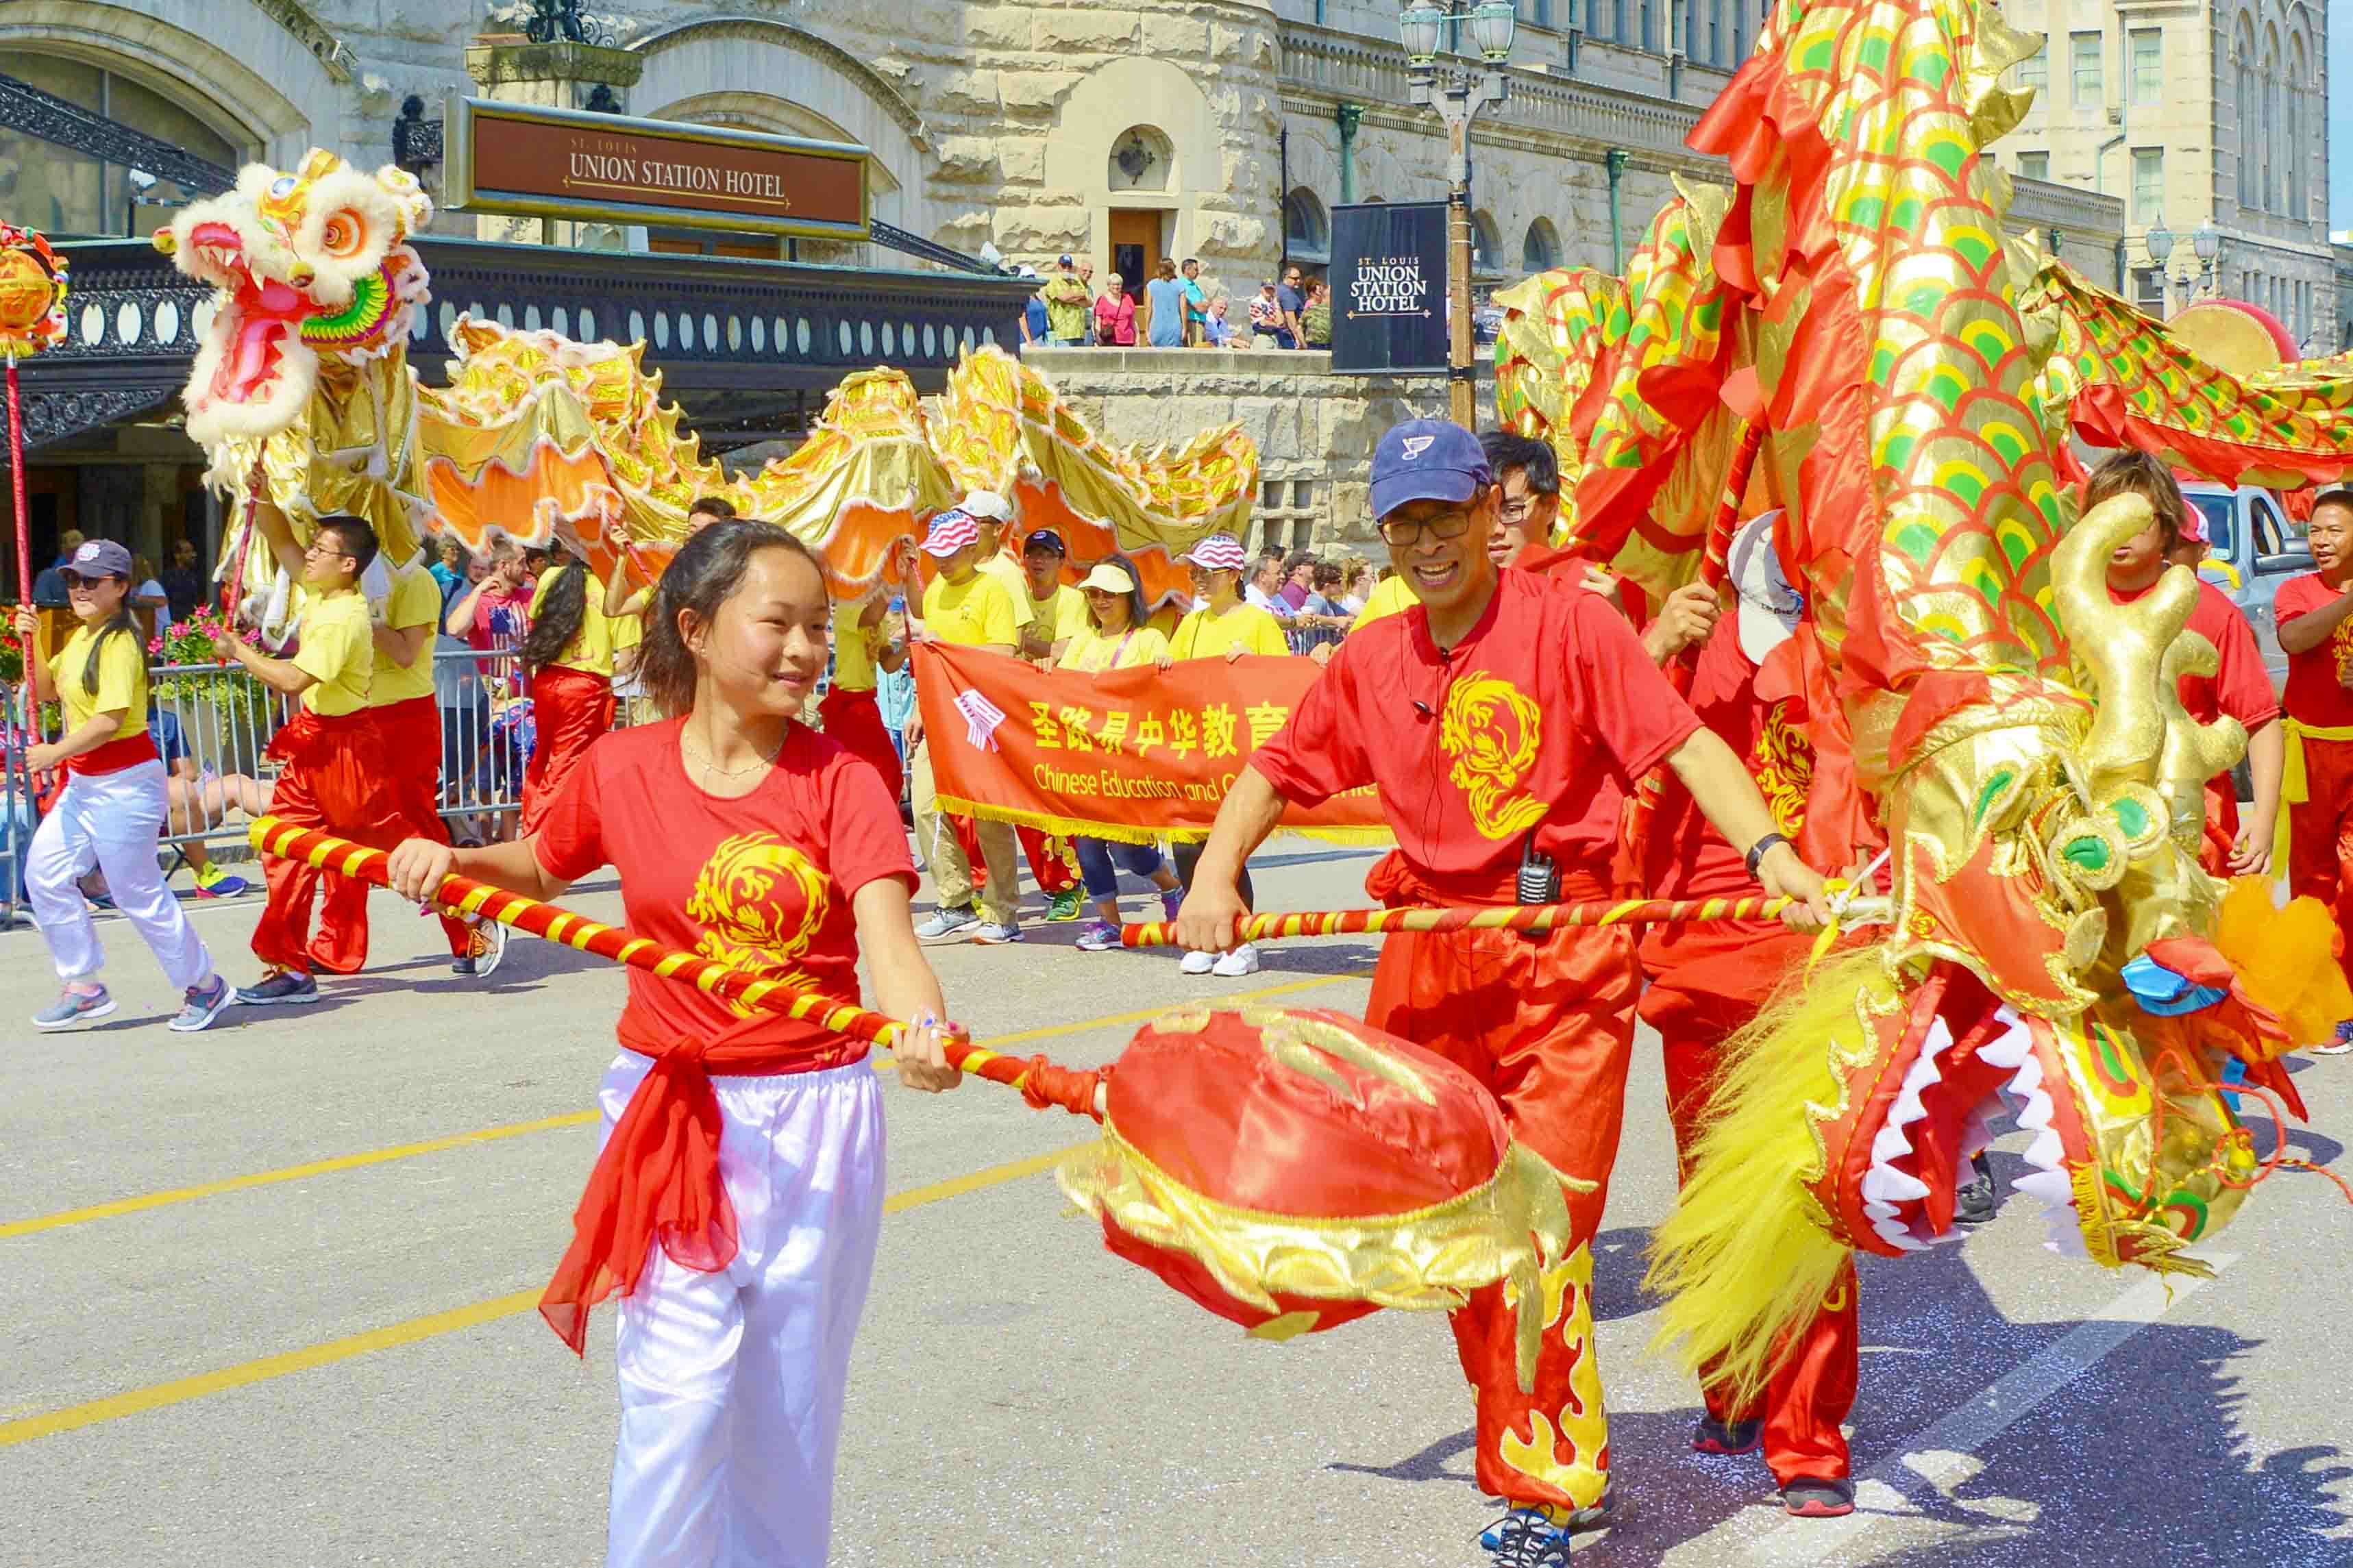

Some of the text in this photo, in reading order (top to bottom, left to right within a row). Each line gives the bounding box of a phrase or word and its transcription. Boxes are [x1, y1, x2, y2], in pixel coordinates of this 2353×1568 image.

[570, 153, 785, 198] UNION STATION HOTEL
[1357, 266, 1419, 281] UNION
[1351, 281, 1427, 297] STATION
[1358, 296, 1420, 311] HOTEL
[1034, 763, 1097, 795] Chinese
[1100, 769, 1182, 800] Education
[1184, 779, 1220, 801] and
